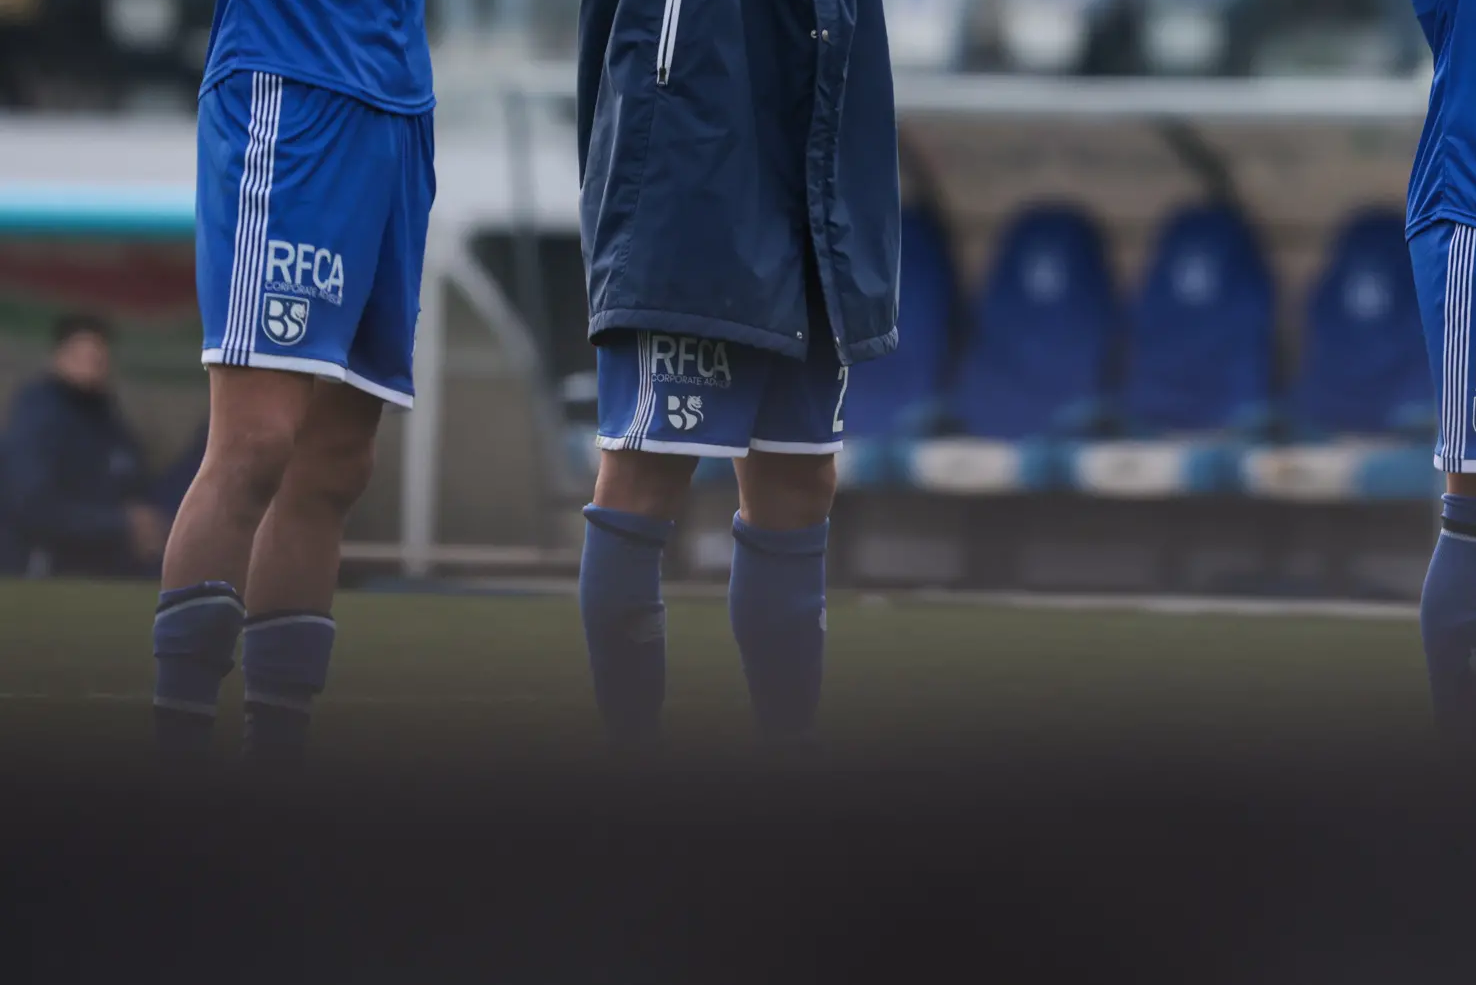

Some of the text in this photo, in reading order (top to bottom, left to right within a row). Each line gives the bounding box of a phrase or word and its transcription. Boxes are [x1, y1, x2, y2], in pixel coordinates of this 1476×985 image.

[265, 239, 344, 298] RFCA
[651, 335, 732, 381] RFCA
[651, 373, 701, 386] CORPORATE
